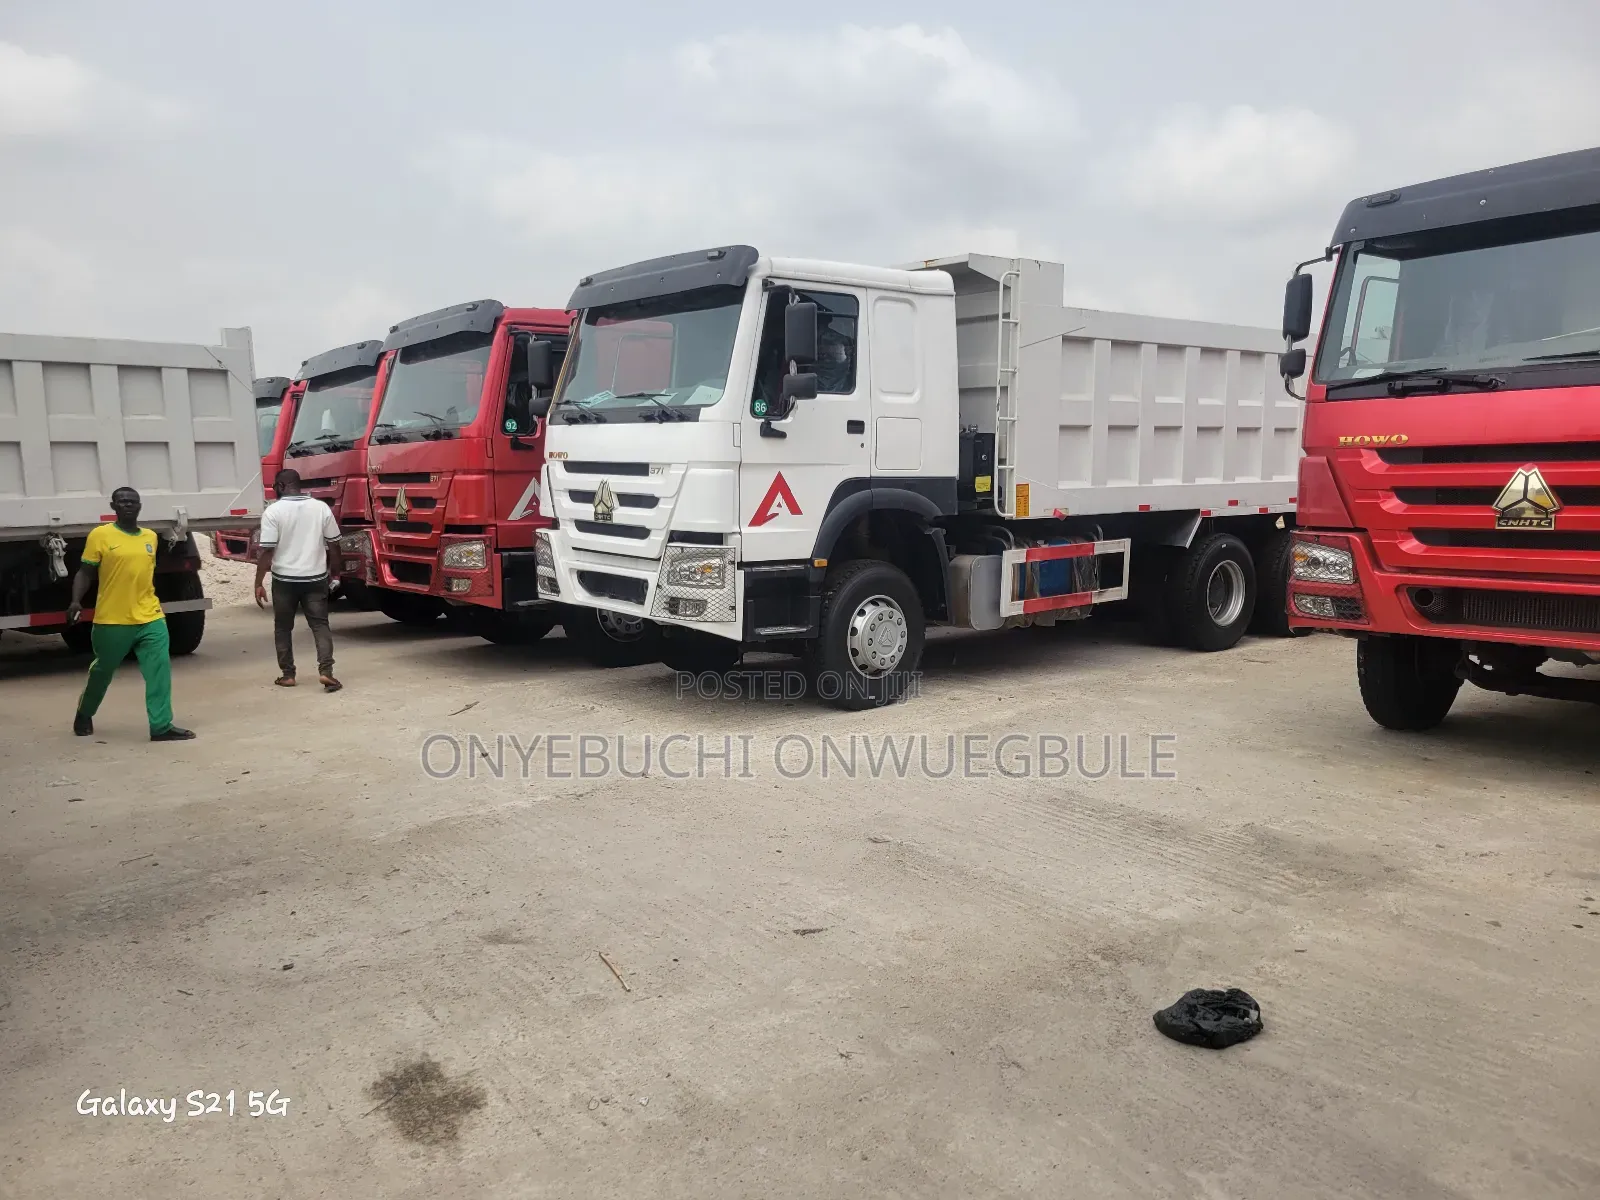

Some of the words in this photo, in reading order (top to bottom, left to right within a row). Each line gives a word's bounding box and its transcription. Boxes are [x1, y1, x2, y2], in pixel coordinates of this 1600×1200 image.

[755, 402, 767, 413] 86
[506, 421, 518, 430] 92
[1338, 434, 1409, 447] HOWO
[649, 467, 664, 475] 371
